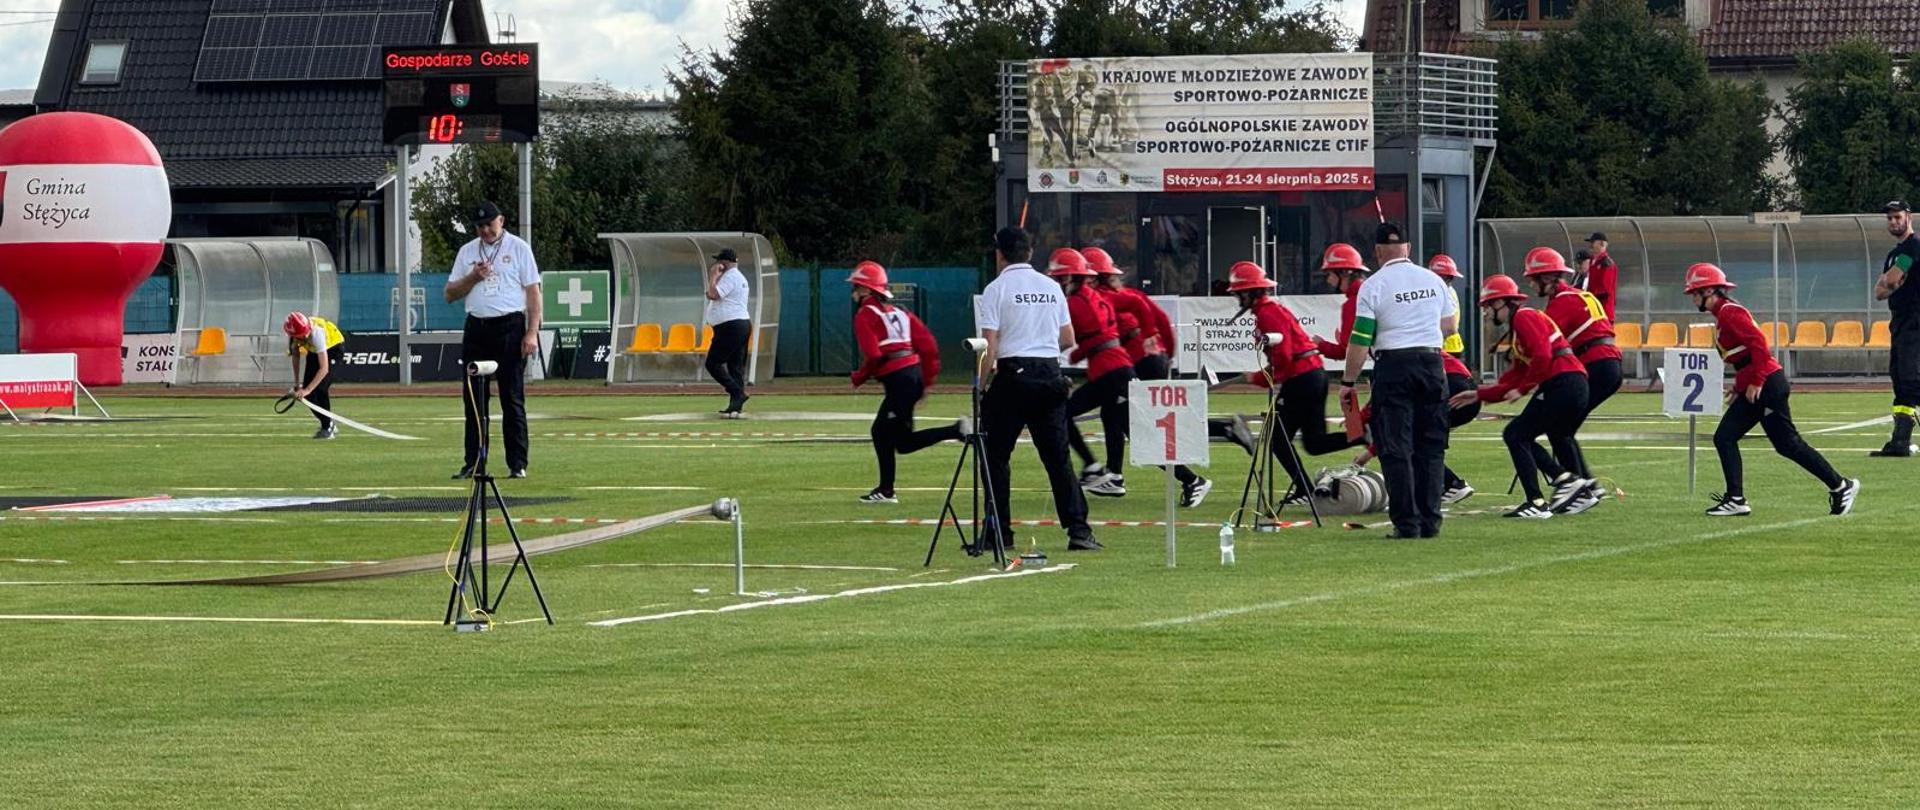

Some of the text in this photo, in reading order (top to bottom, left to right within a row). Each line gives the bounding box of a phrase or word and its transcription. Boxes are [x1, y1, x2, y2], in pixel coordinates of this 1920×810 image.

[386, 51, 530, 70] Gospodarze Goście
[1102, 67, 1368, 83] KRAJOWE MŁODZIEŻOWE ZAWODY
[1174, 86, 1368, 102] SPORTOWO-POŻARNICZE
[1165, 117, 1368, 133] OGÓLNOPOLSKIE ZAWODY
[1136, 137, 1369, 153] SPORTOWO-POŻARNICZE CTIF
[26, 177, 86, 195] Gmina
[1225, 174, 1262, 185] 21-24
[1266, 173, 1321, 186] sierpnia
[1325, 173, 1358, 184] 2025
[1362, 175, 1371, 184] r.
[23, 202, 90, 229] Stężyca
[1015, 294, 1057, 305] SĘDZIA
[1395, 289, 1437, 304] SĘDZIA
[1679, 353, 1709, 370] TOR
[1148, 385, 1187, 407] TOR
[1683, 373, 1704, 412] 2
[1156, 411, 1176, 461] 1
